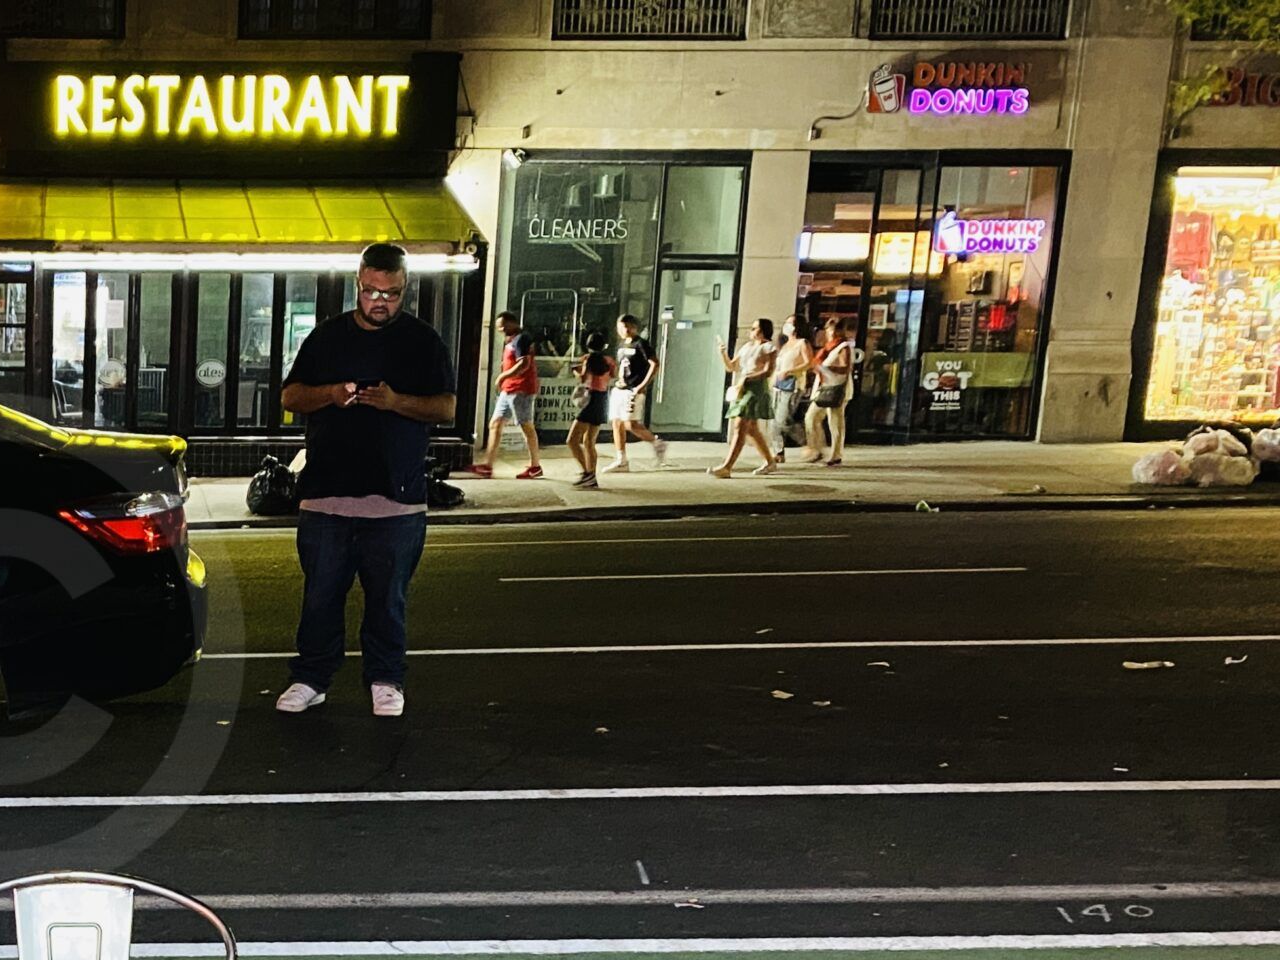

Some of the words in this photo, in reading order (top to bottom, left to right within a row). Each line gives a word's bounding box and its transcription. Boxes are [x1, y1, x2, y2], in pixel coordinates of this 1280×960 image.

[54, 75, 410, 134] RESTAURANT
[909, 88, 1030, 114] DONUTS
[528, 218, 628, 239] CLEANERS
[966, 237, 1037, 251] DONUTS
[936, 360, 962, 371] YOU
[923, 371, 973, 390] GOT
[540, 386, 556, 396] DAY
[932, 391, 960, 401] THIS
